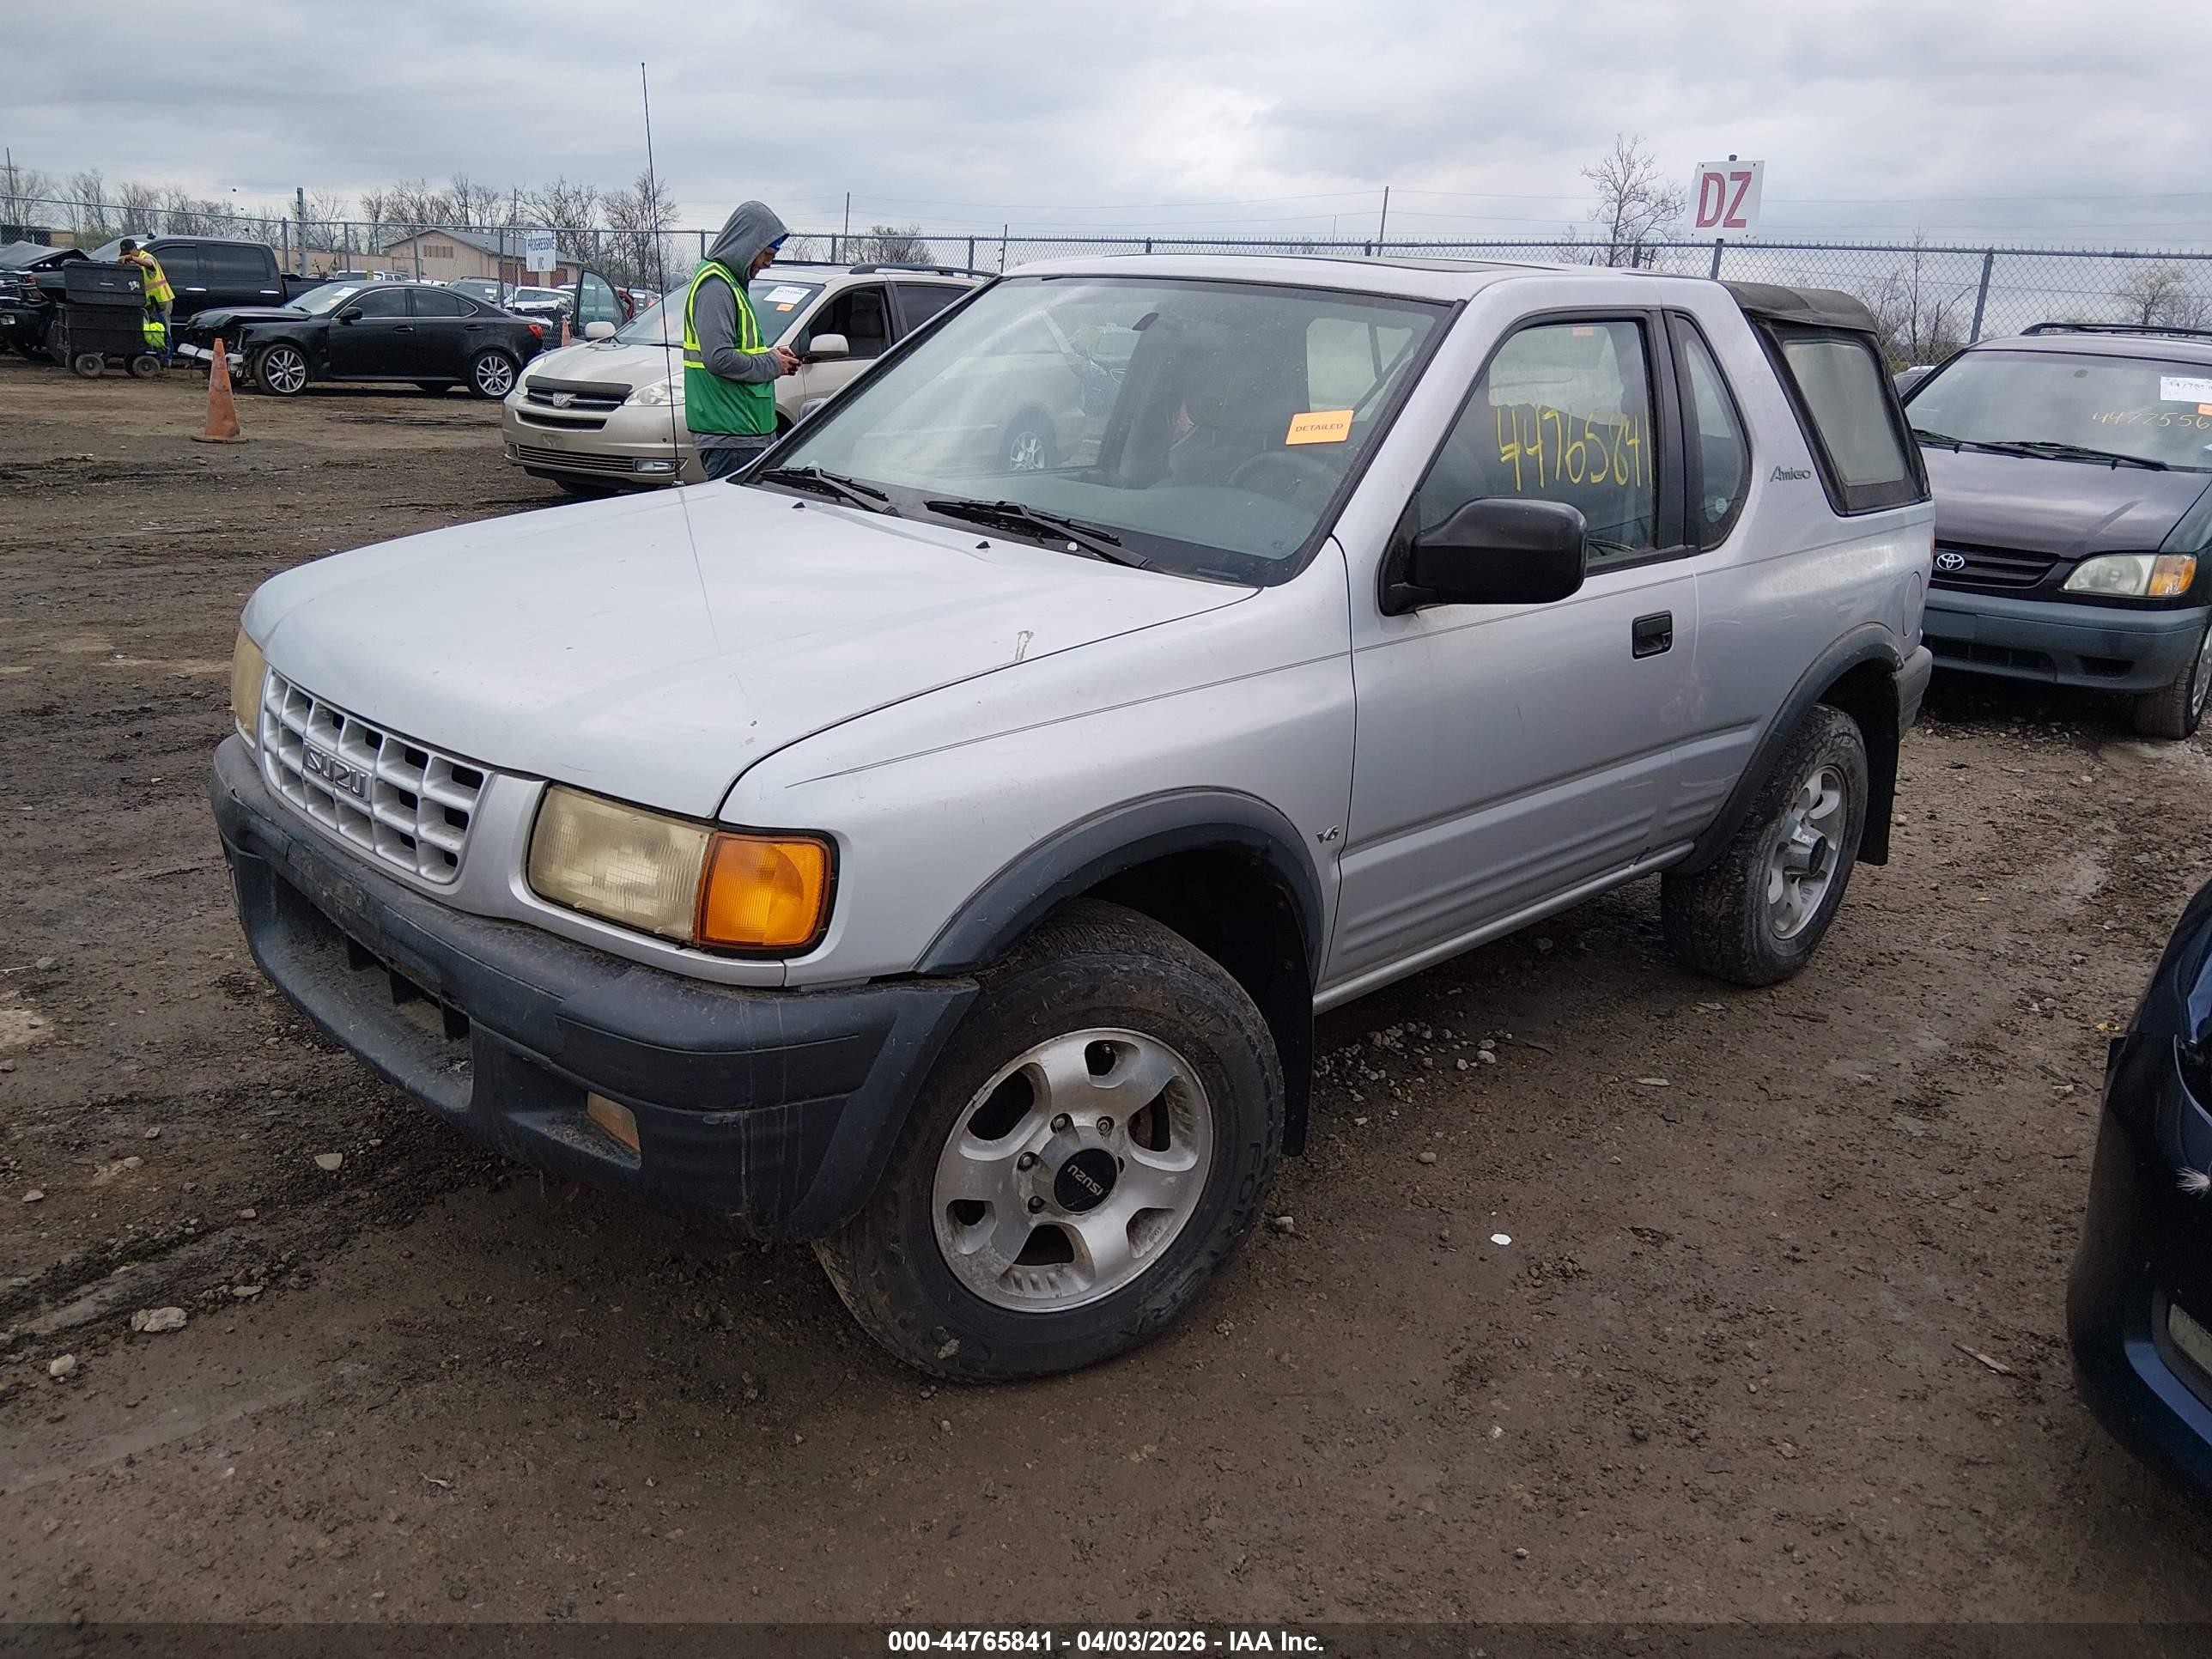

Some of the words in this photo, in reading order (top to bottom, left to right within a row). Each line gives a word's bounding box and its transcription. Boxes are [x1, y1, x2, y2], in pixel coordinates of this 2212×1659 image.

[1696, 172, 1752, 228] DZ
[1295, 423, 1344, 432] DETAILED
[2093, 411, 2212, 429] 4477556
[1497, 402, 1653, 493] 44765841
[1770, 466, 1811, 482] Amigo
[303, 742, 367, 799] ISUZU
[1316, 824, 1339, 844] V6
[1067, 1164, 1104, 1196] ISUZU
